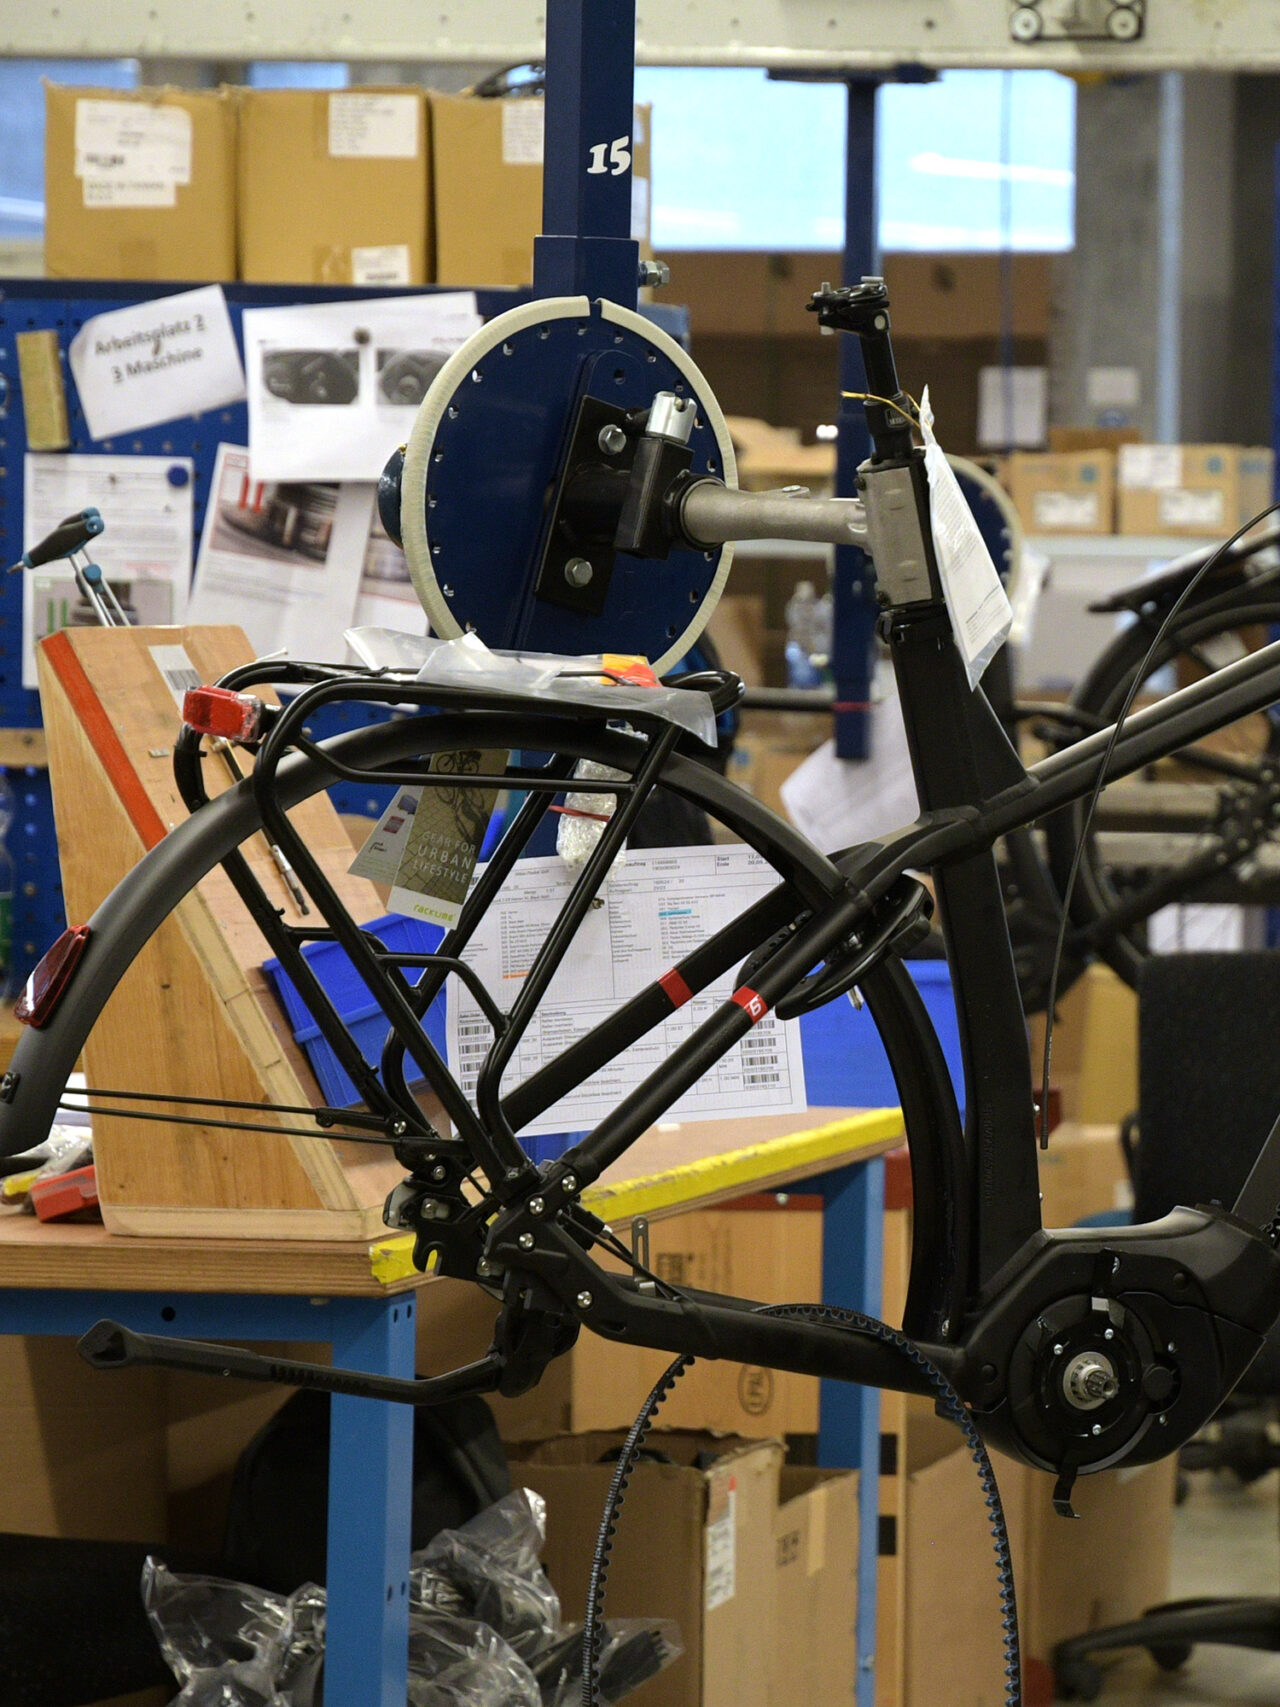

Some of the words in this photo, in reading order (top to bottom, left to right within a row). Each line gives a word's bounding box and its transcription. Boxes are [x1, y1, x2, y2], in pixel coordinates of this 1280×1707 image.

[587, 135, 632, 176] 15
[95, 321, 191, 355] Arbeitsplatz
[126, 347, 204, 376] Maschine
[422, 831, 450, 847] GEAR
[455, 840, 477, 854] FOR
[417, 845, 473, 870] URBAN
[413, 860, 469, 884] LIFESTYLE
